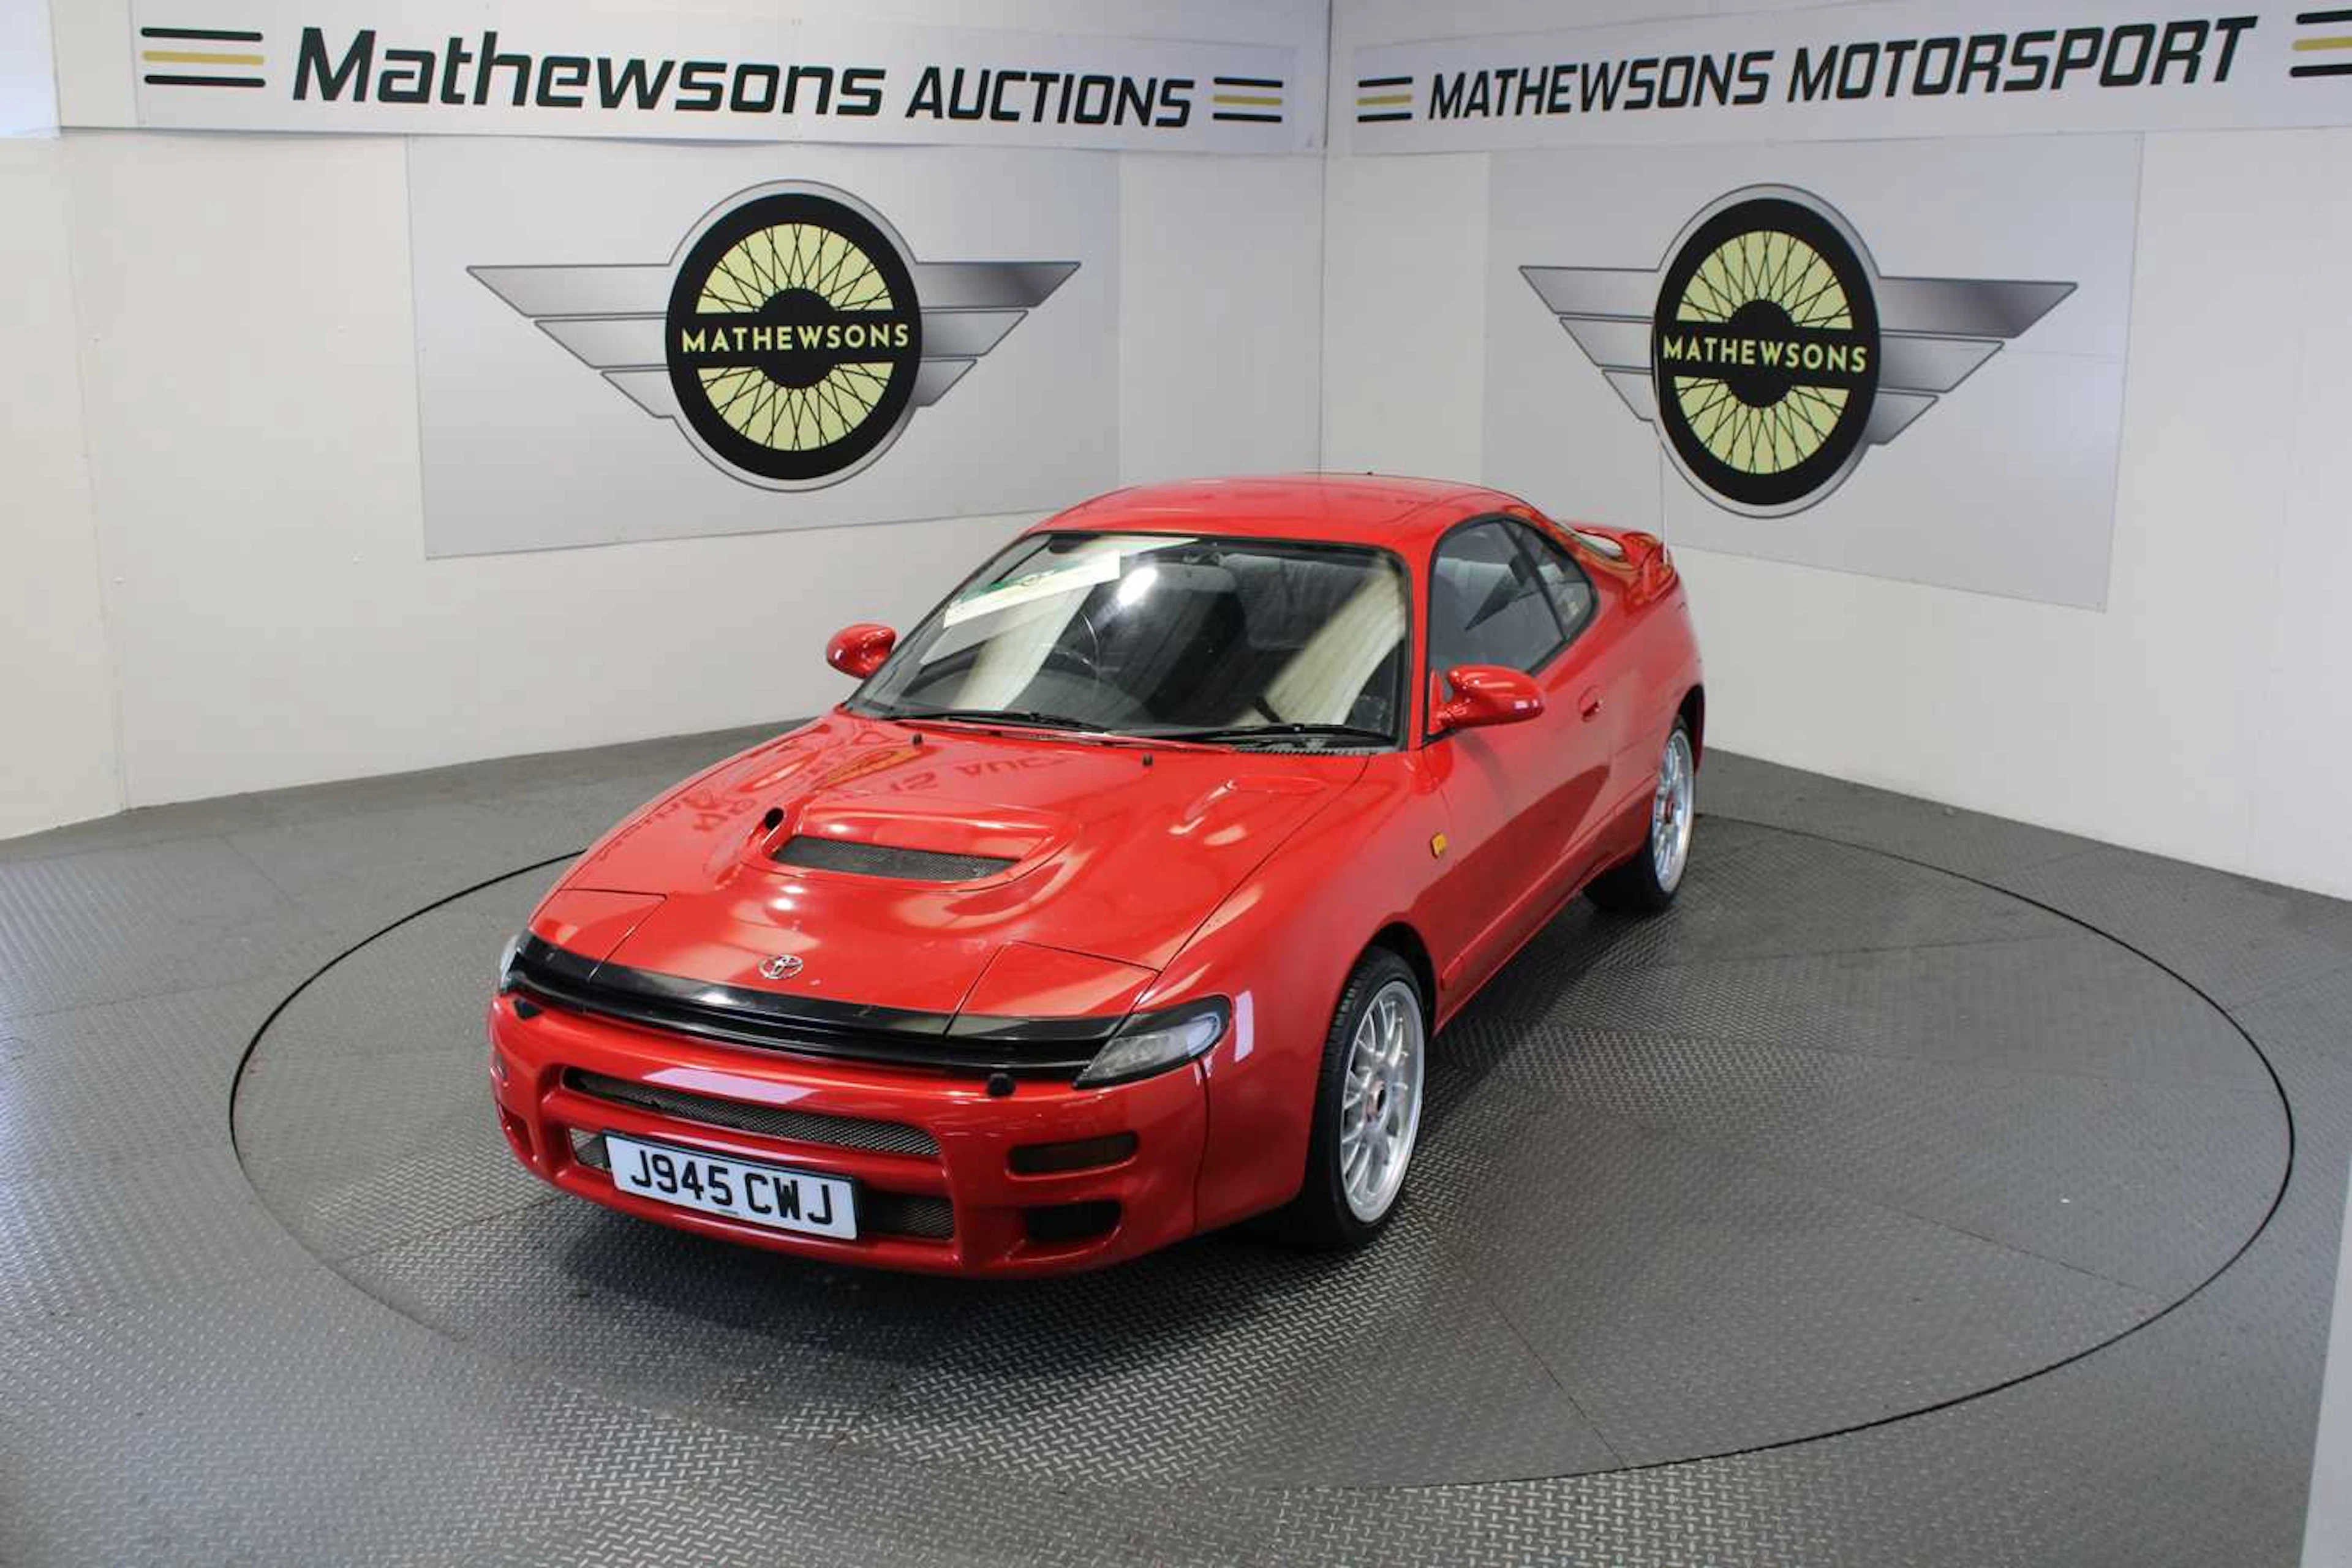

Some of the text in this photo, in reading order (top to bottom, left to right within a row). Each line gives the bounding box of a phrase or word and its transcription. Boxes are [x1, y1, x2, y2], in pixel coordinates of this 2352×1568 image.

[292, 26, 1196, 128] Mathewsons AUCTIONS
[1428, 15, 2259, 120] MATHEWSONS MOTORSPORT
[681, 323, 909, 353] MATHEWSONS
[1662, 335, 1868, 373] MATHEWSONS
[631, 1150, 833, 1225] J945 CWJ
